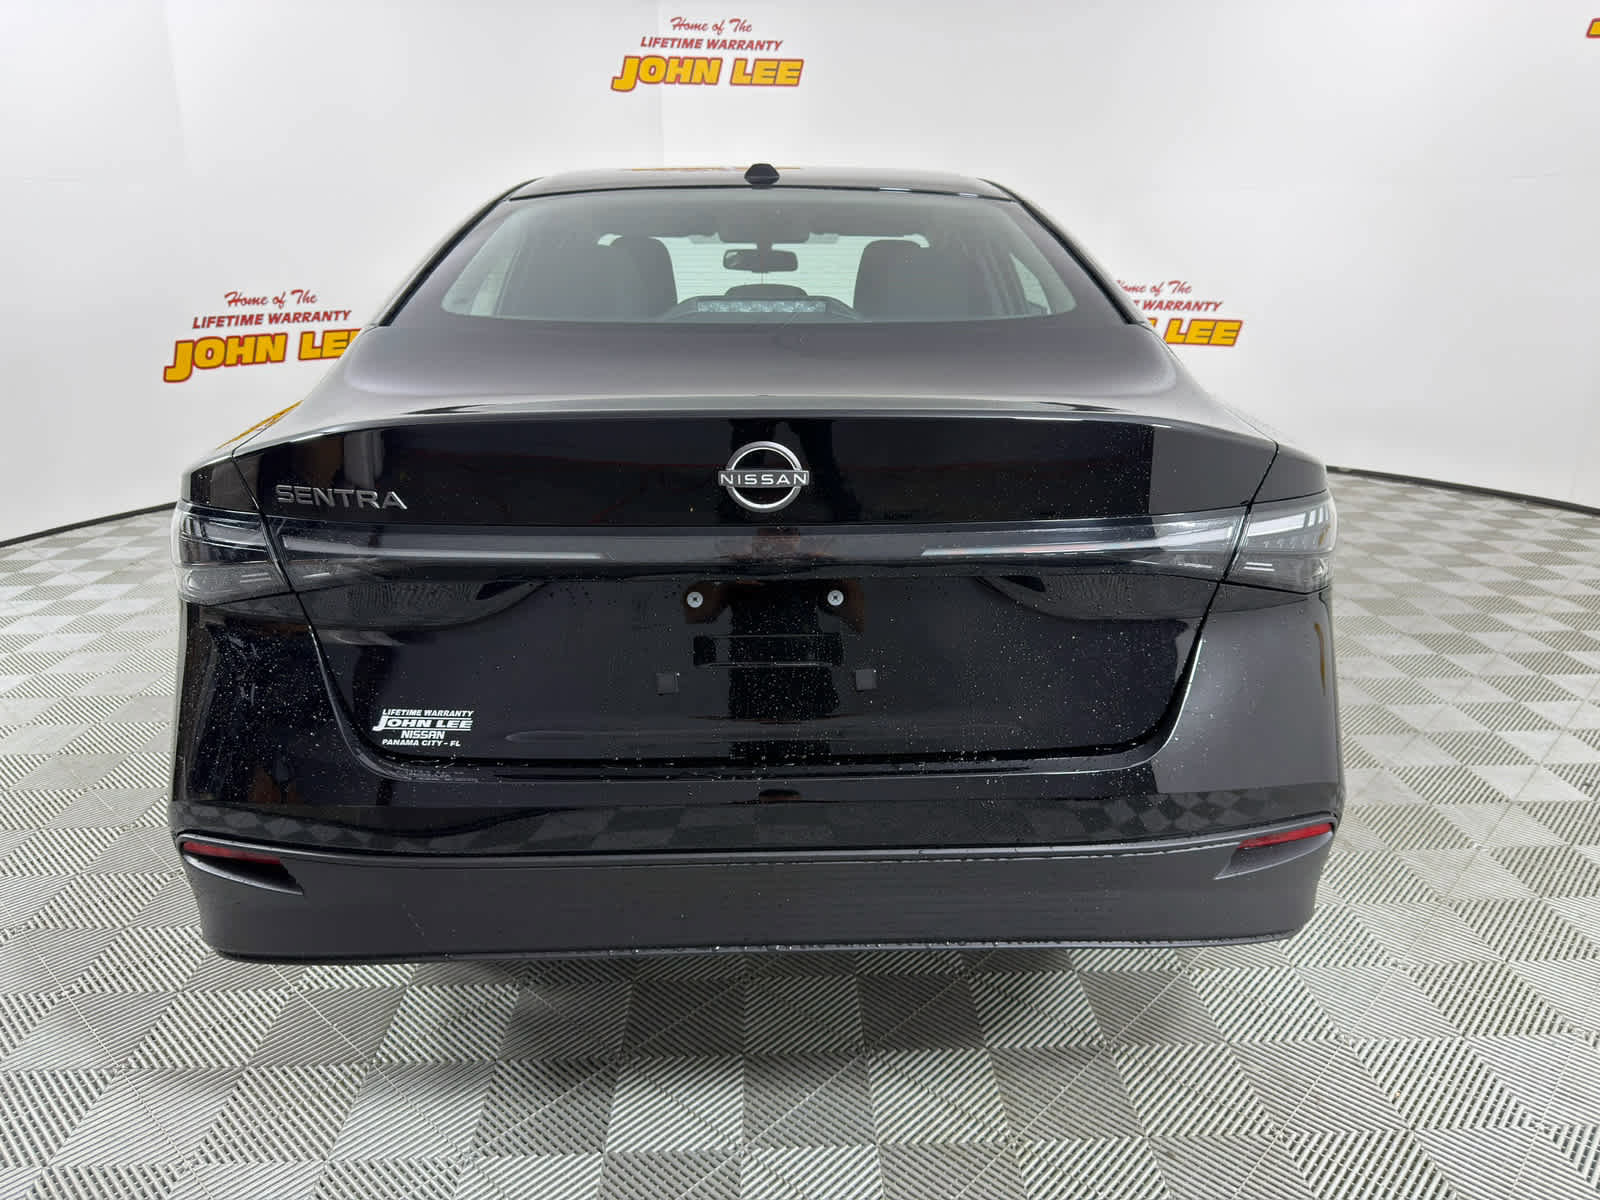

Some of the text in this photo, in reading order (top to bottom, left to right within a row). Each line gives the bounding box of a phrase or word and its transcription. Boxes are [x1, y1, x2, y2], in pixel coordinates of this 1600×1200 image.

[670, 16, 753, 36] Home of The
[640, 36, 784, 52] LIFETIME WARRANTY
[611, 55, 804, 92] JOHN LEE
[1149, 282, 1165, 297] of
[1168, 280, 1192, 294] The
[224, 289, 318, 309] Home of The
[1142, 300, 1223, 312] WARRANTY
[192, 310, 352, 329] LIFETIME WARRANTY
[1163, 318, 1243, 347] LEE
[163, 333, 288, 383] JOHN
[720, 473, 807, 485] NISSAN
[275, 484, 408, 510] SENTRA
[372, 716, 473, 731] JOHN LEE
[401, 731, 445, 739] NISSAN
